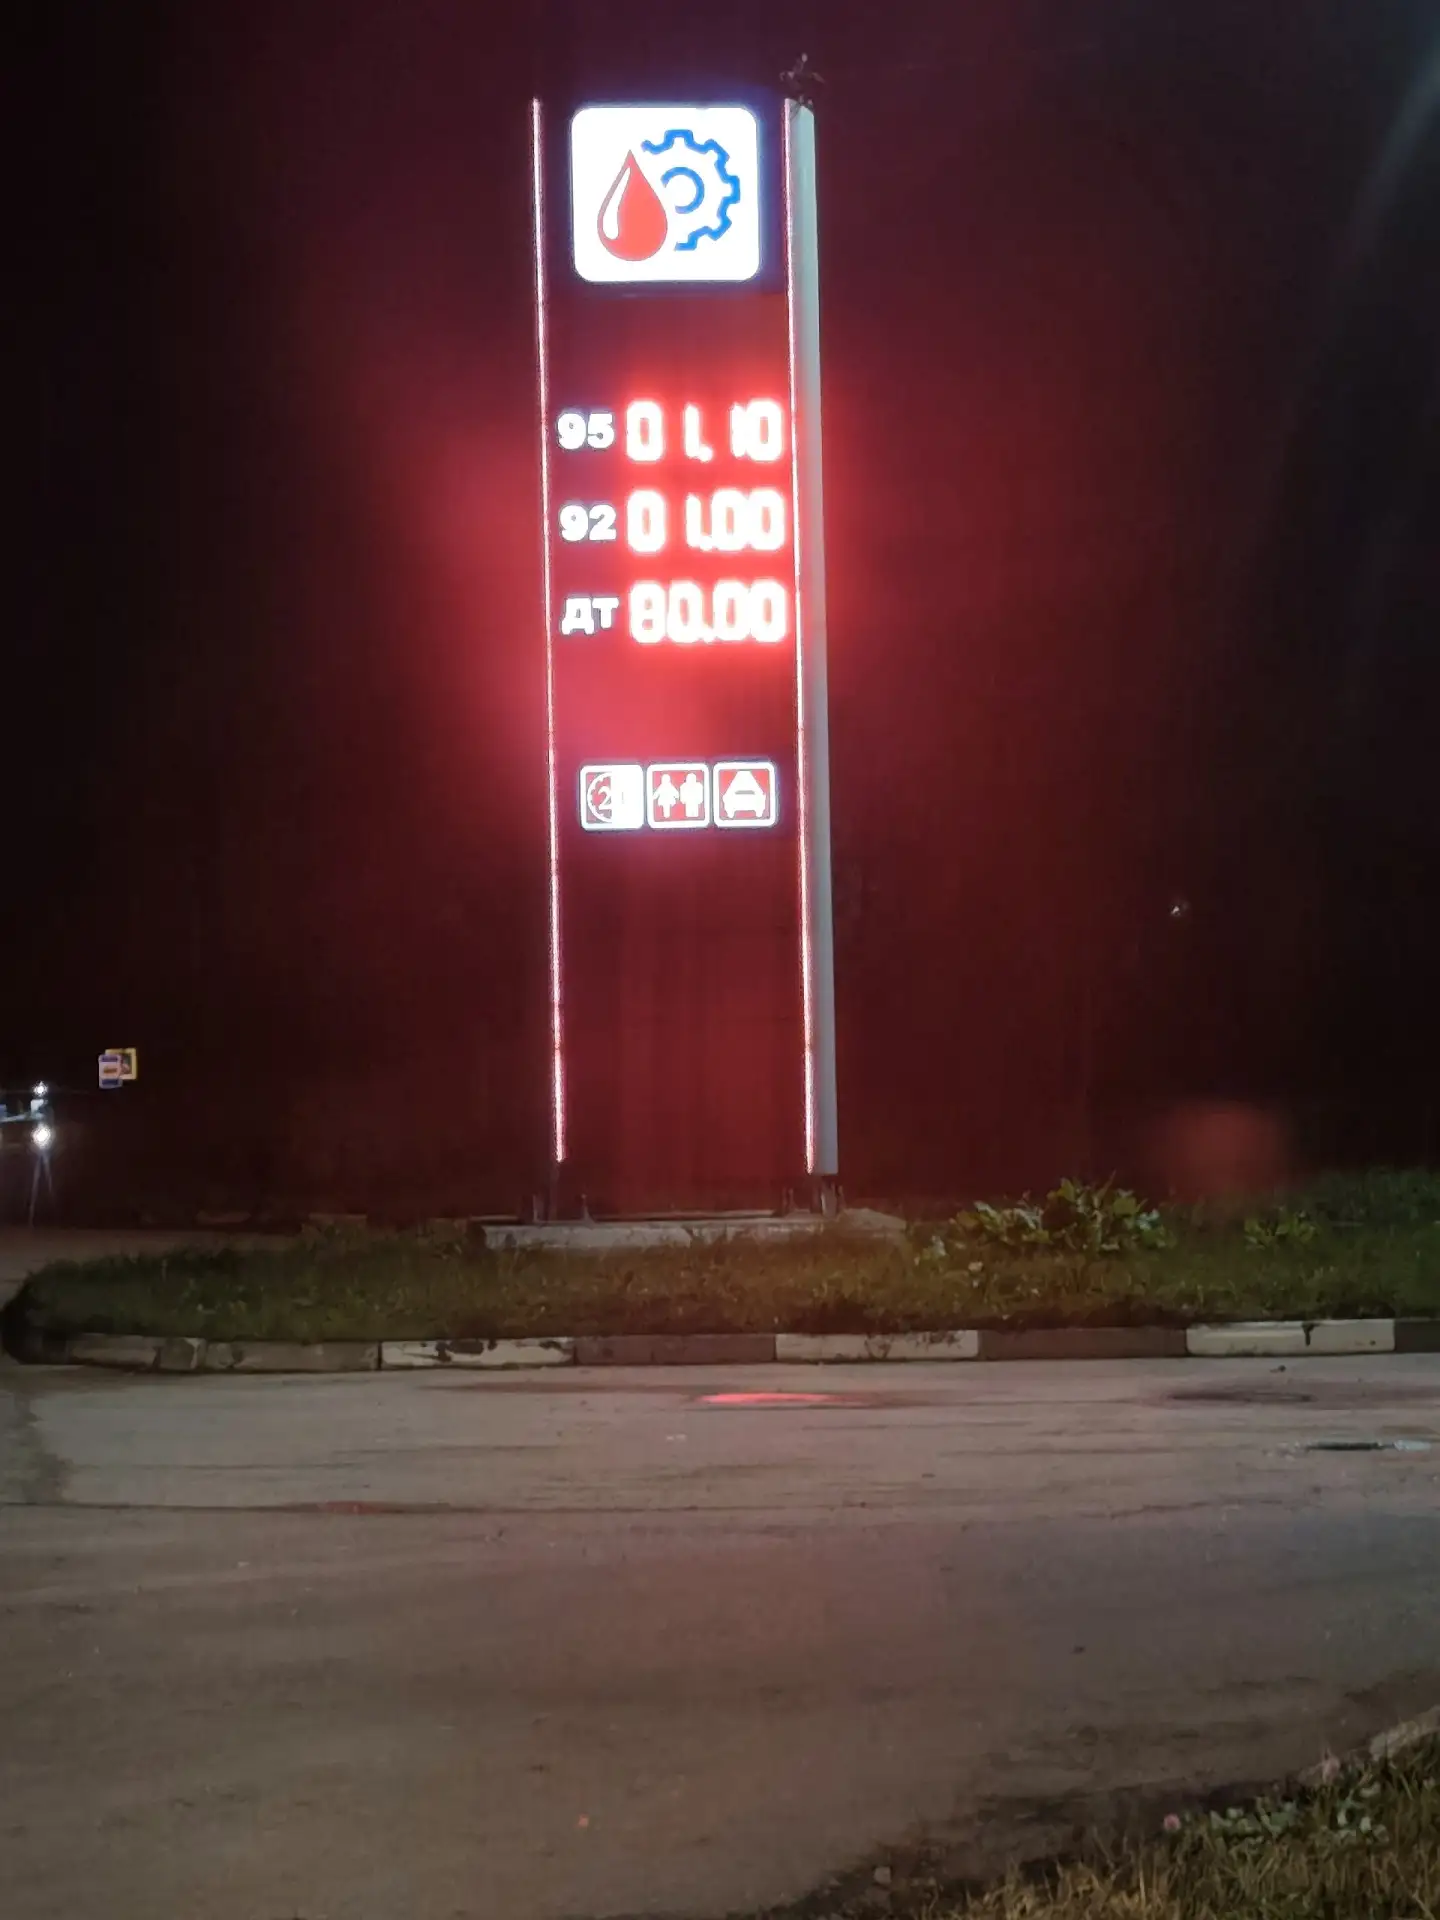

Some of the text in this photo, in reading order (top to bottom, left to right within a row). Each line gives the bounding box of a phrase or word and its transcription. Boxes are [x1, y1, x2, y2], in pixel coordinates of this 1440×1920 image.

[557, 412, 615, 450] 95
[559, 504, 617, 542] 92
[561, 597, 620, 635] ДТ
